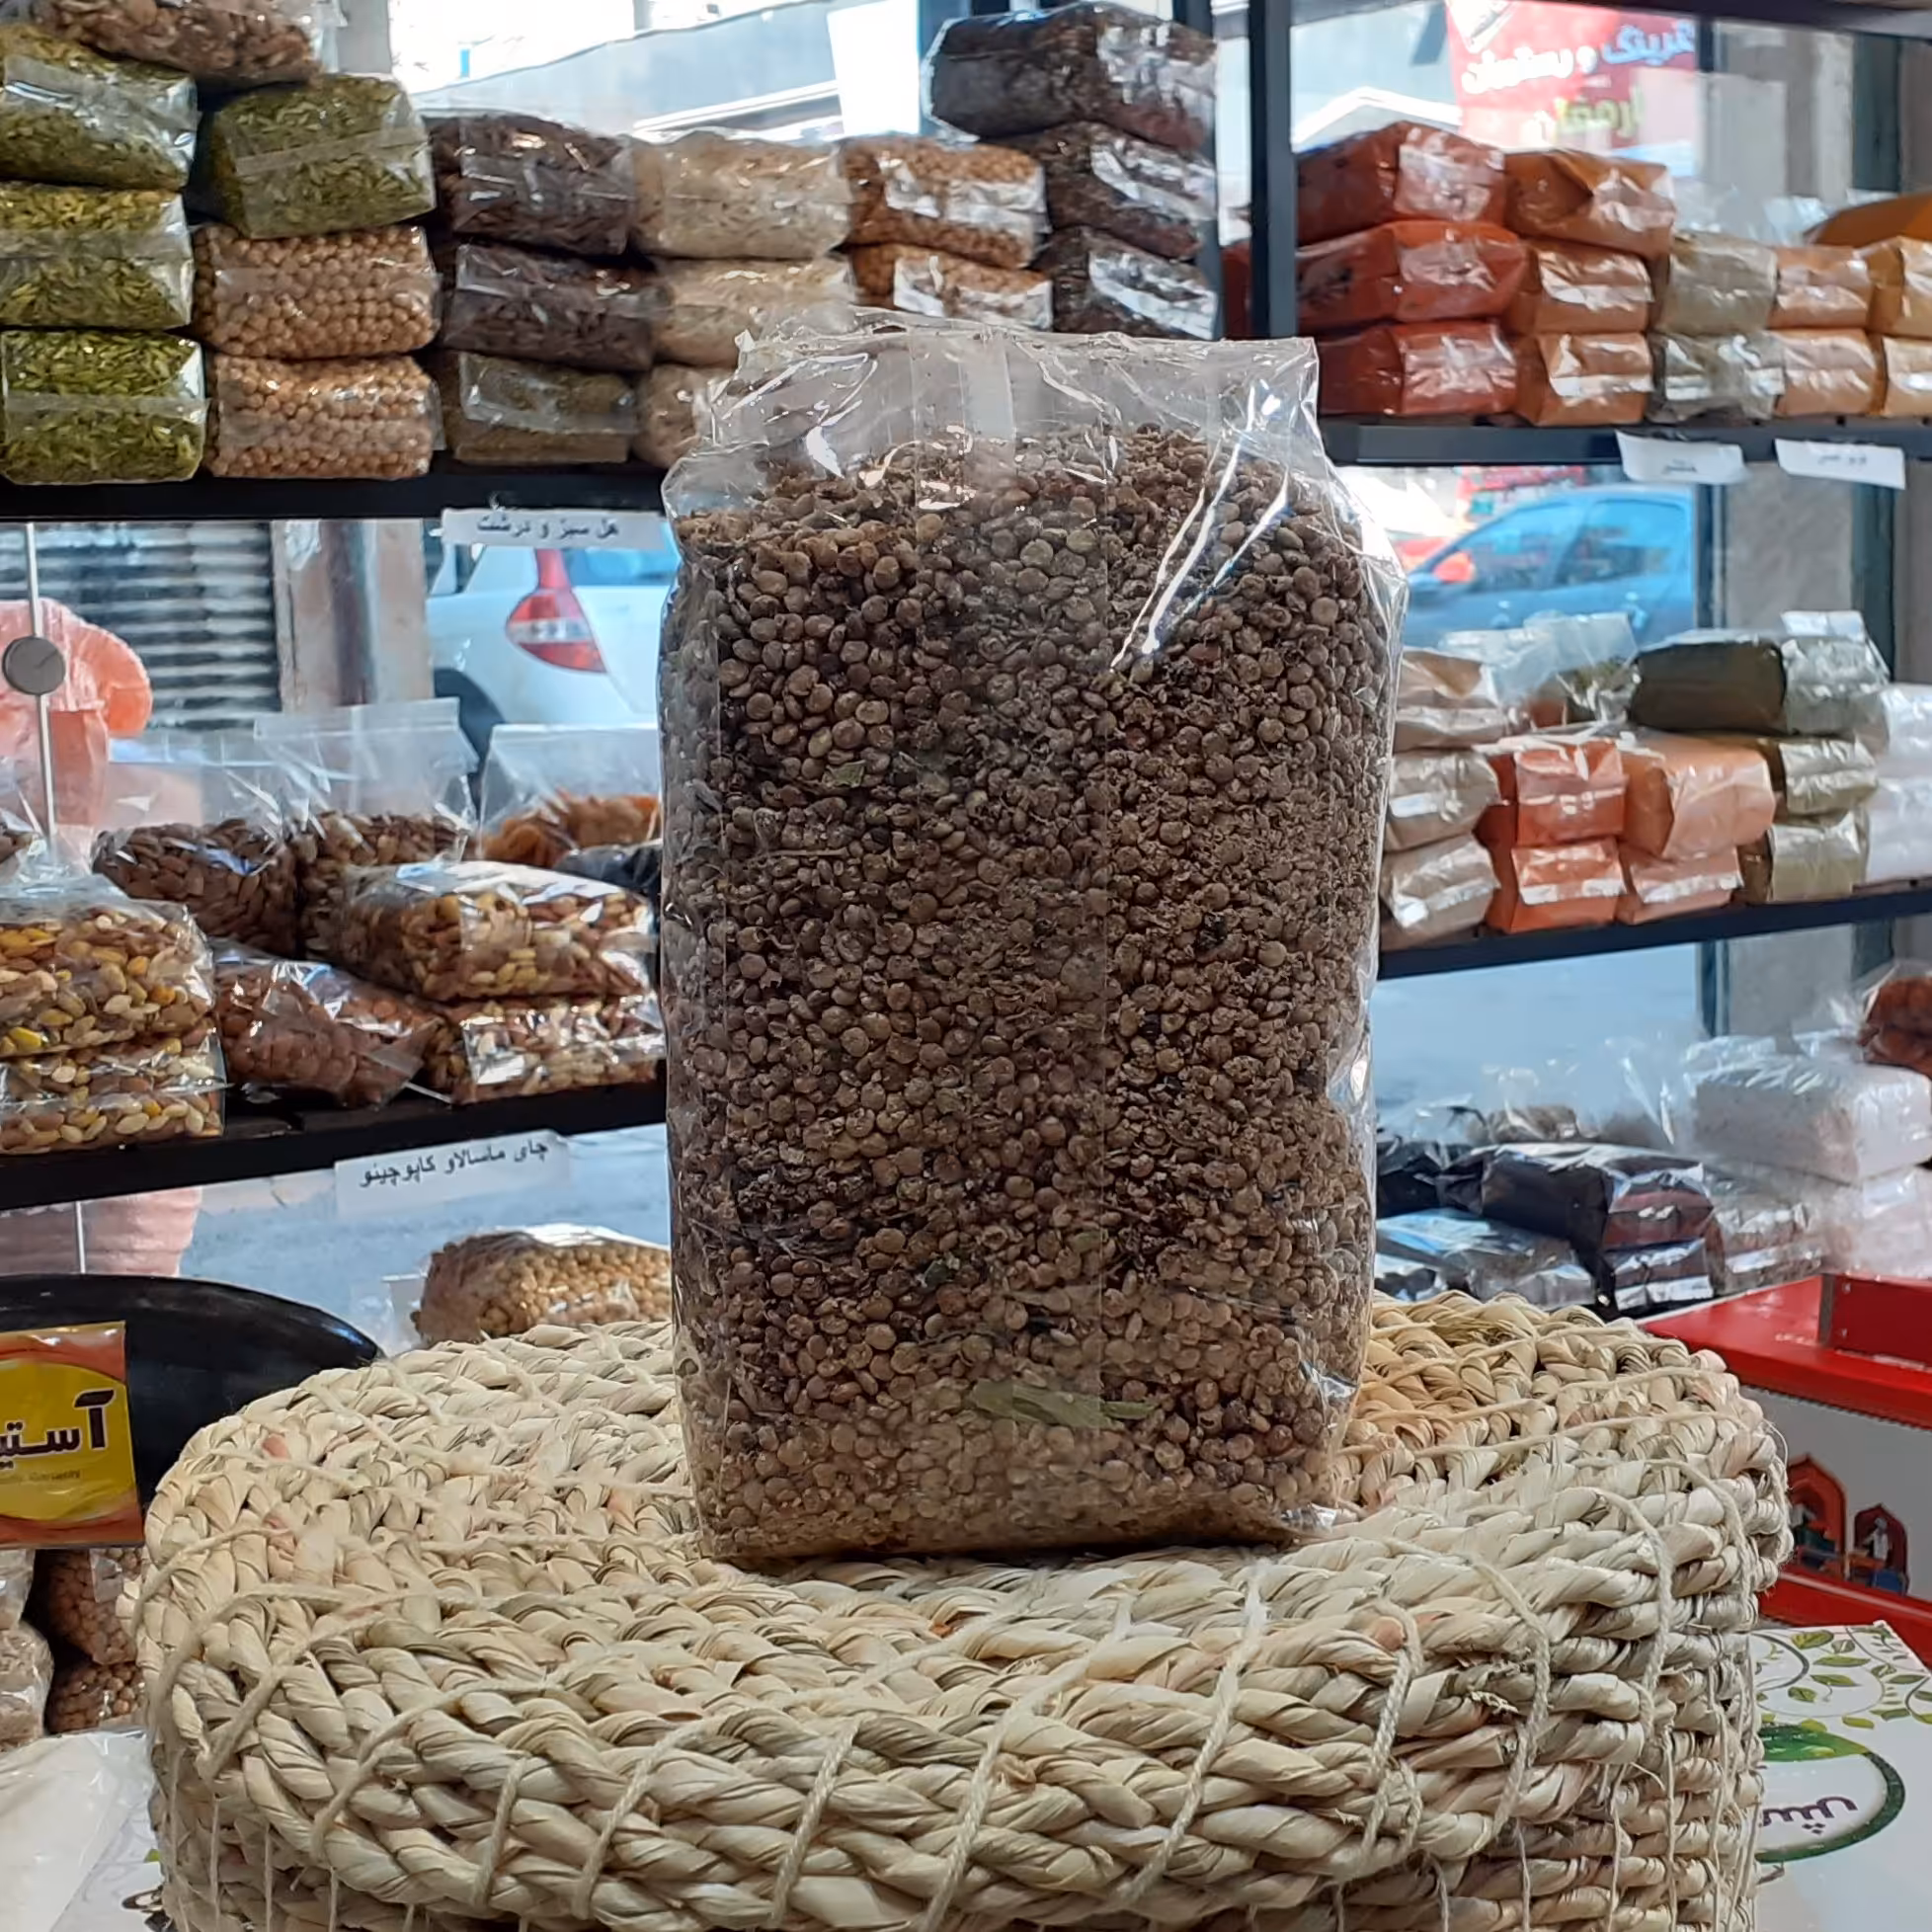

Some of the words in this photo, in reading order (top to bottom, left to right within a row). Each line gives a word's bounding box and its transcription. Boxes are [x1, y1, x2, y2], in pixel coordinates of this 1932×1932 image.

[477, 513, 531, 538] درشت
[559, 518, 590, 540] سبز
[359, 1154, 436, 1187] کاپوچینو
